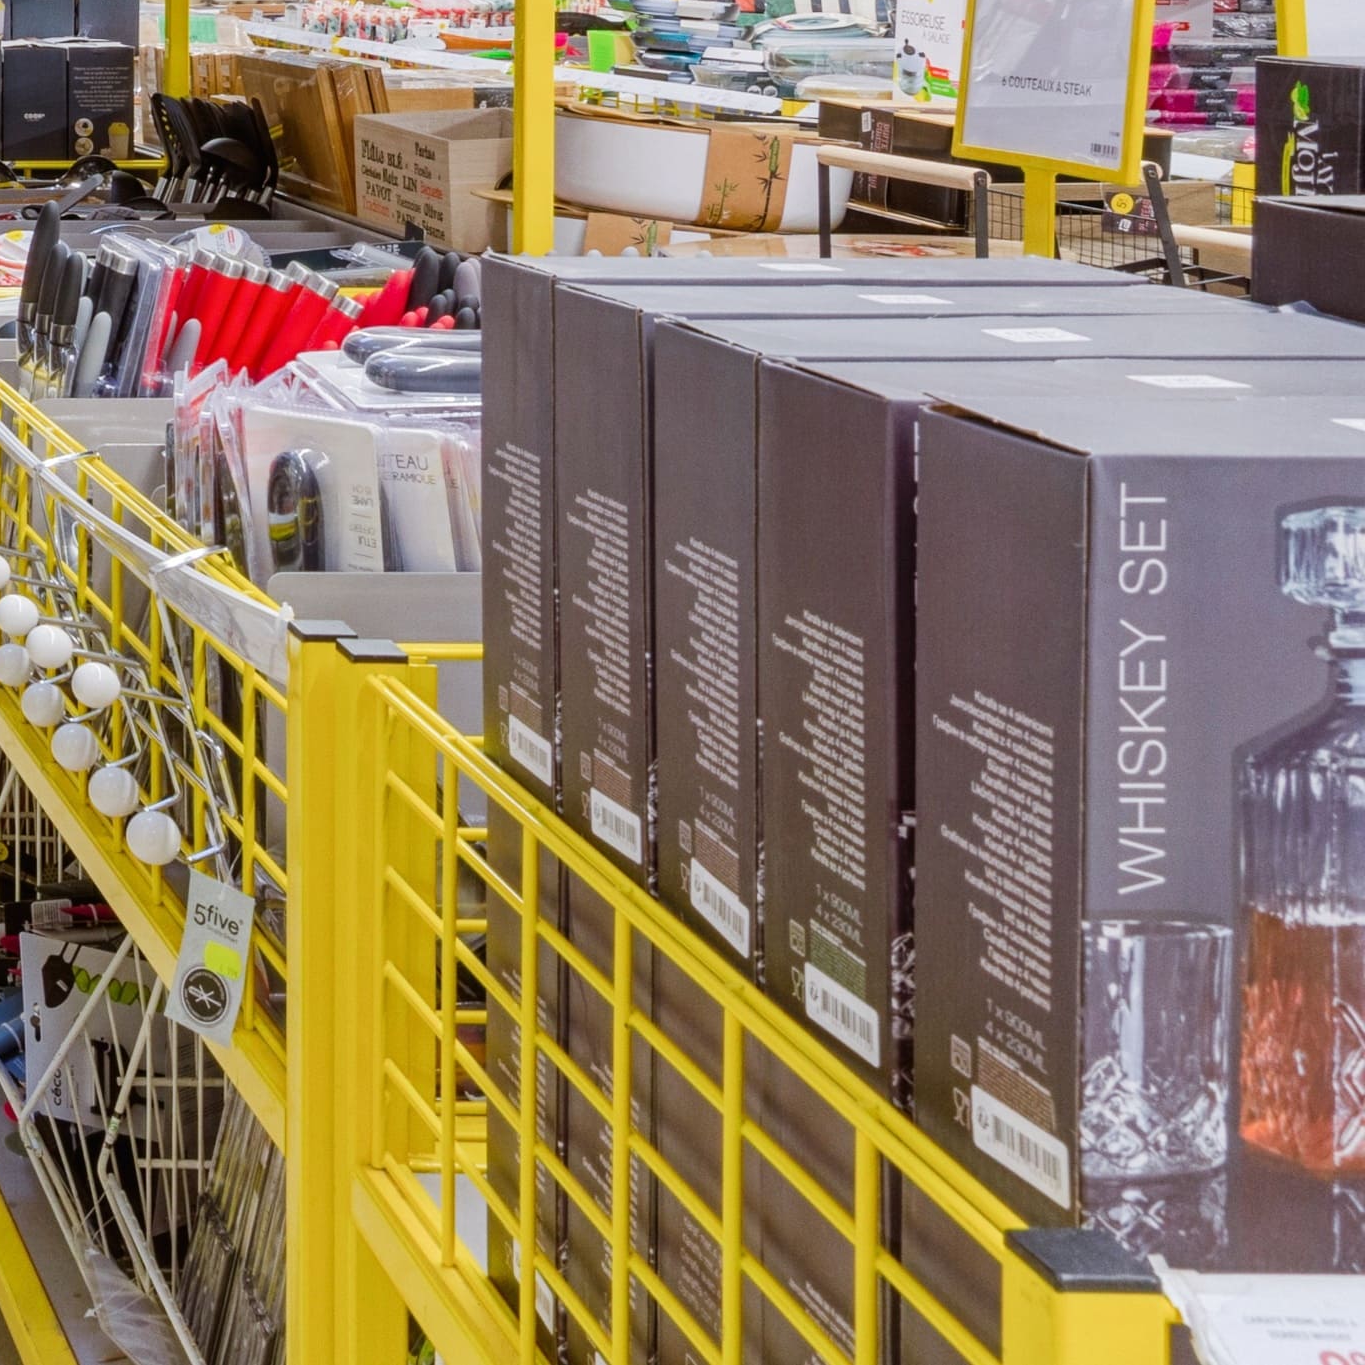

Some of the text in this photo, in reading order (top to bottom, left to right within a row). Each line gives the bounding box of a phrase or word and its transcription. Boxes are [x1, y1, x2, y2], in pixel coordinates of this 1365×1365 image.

[900, 10, 946, 31] ESSOREUSE
[1008, 75, 1054, 92] COUTEAUX
[1063, 82, 1094, 97] STEAK
[387, 148, 403, 170] BLÉ
[365, 181, 392, 202] PAVOT
[402, 175, 418, 193] LIN
[1119, 482, 1168, 597] SET
[1117, 618, 1168, 896] WHISKEY
[193, 902, 241, 937] 5five
[1006, 1010, 1048, 1050] 900ML
[1005, 1031, 1048, 1075] 230ML
